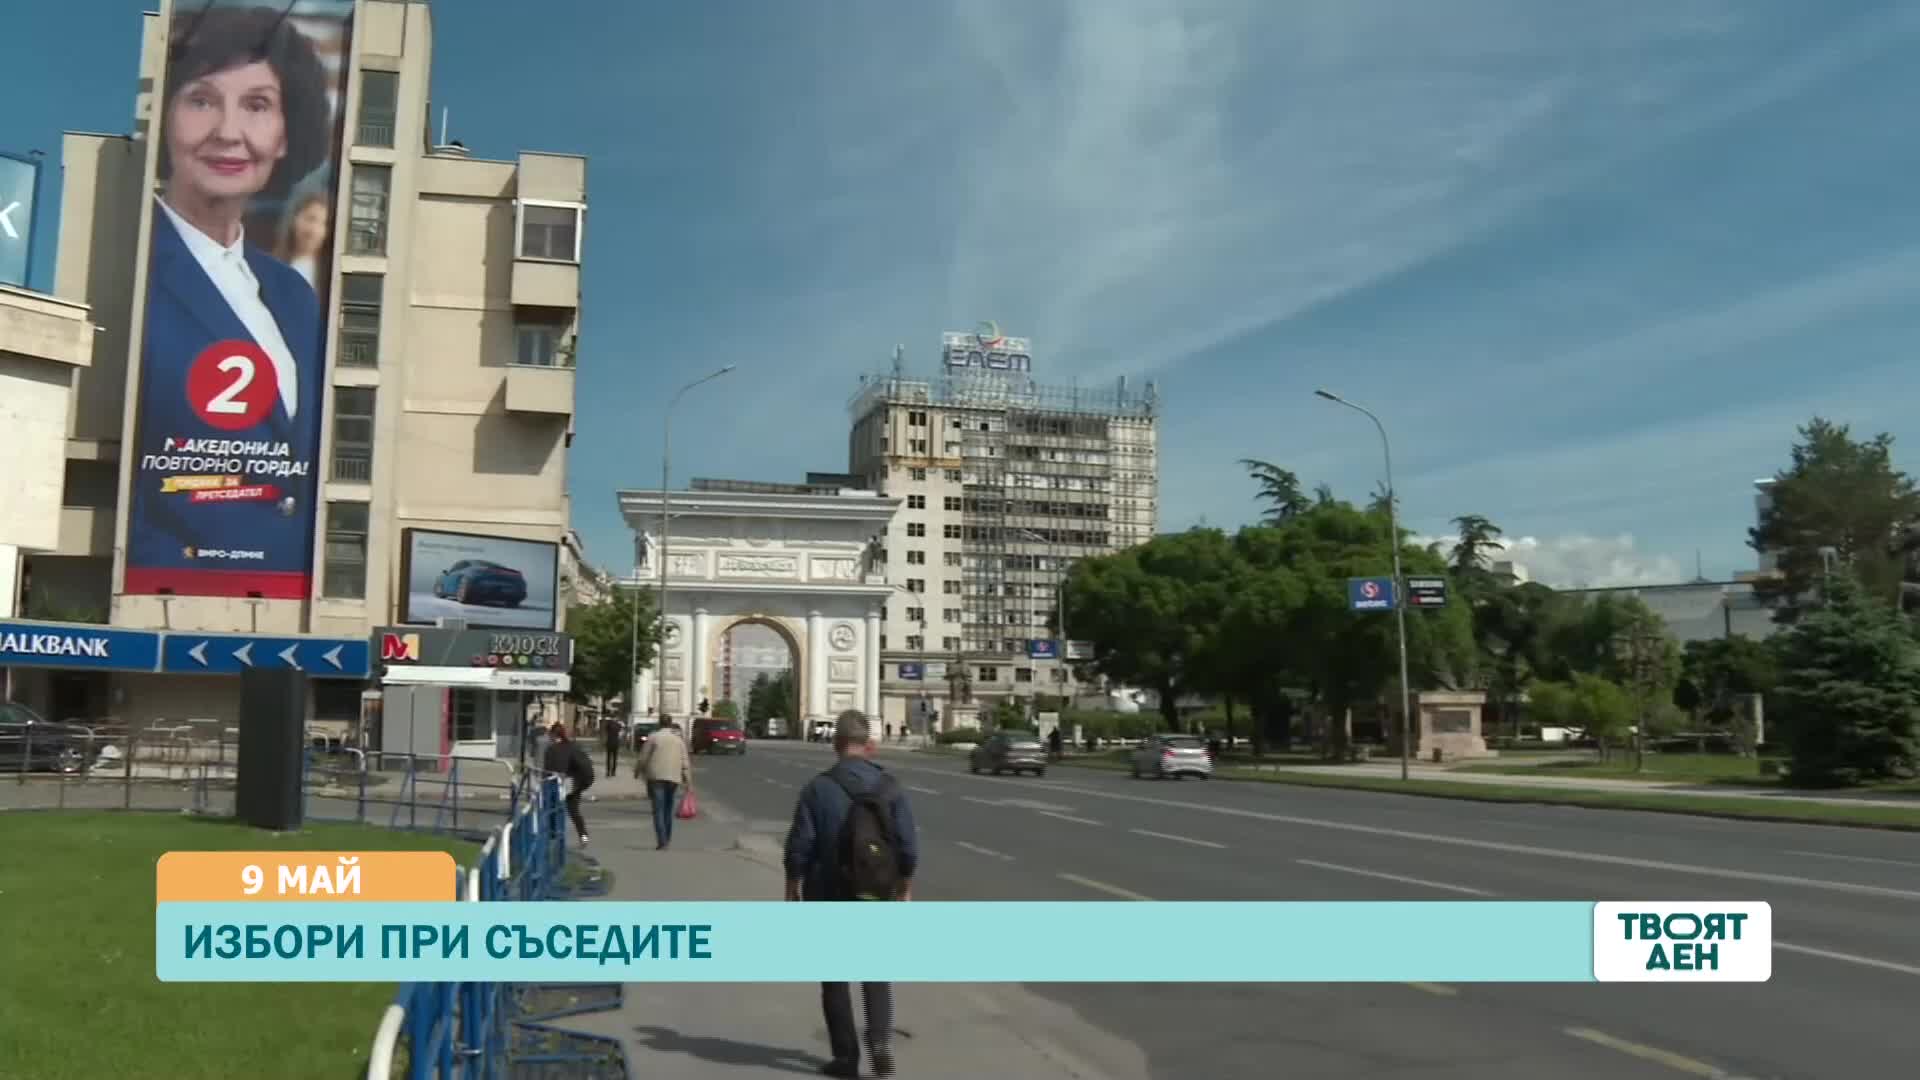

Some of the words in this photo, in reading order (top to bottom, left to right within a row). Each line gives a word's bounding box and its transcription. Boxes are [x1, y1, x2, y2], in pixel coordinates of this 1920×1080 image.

[205, 354, 256, 414] 2
[164, 437, 290, 456] МАКЕДОНИЈА
[142, 455, 242, 473] ПОВТОРНО
[245, 460, 309, 476] ГОРДА!
[0, 632, 109, 657] ALKBANK
